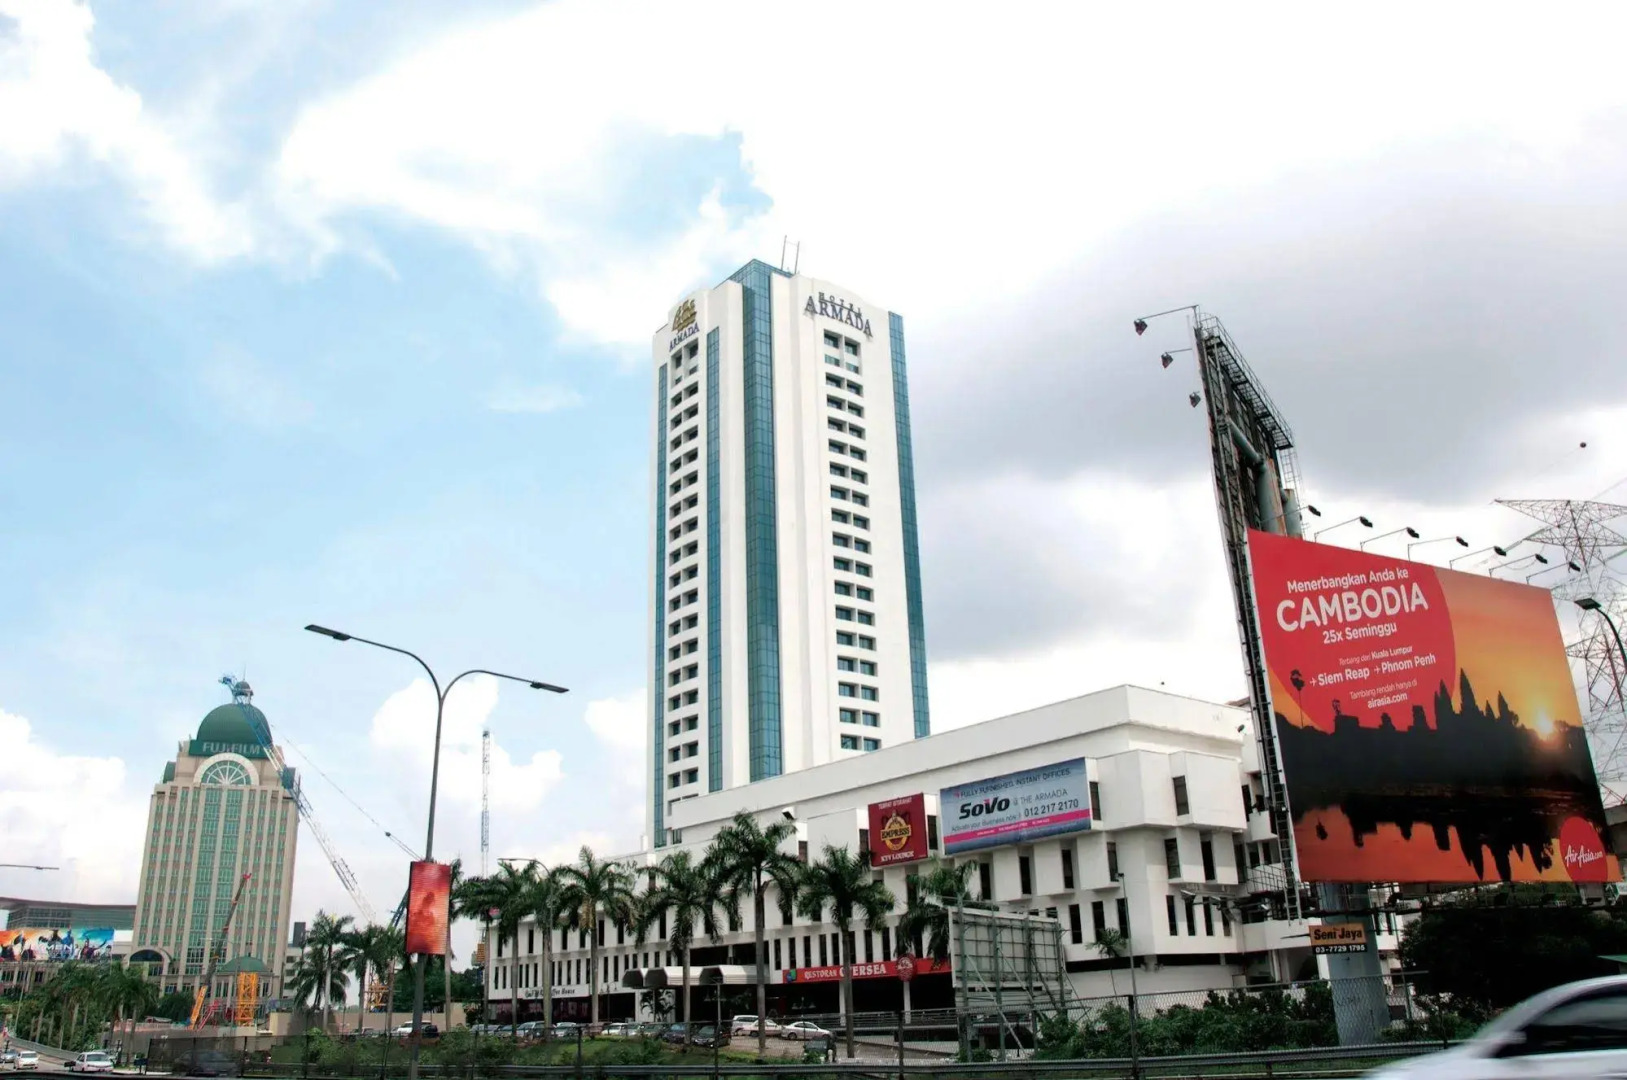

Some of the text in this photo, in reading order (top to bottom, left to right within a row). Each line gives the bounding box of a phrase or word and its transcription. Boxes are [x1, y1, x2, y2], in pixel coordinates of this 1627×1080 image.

[804, 296, 873, 337] ARMADA
[669, 322, 700, 352] ARMADA
[1287, 567, 1409, 594] Menerbangkan Anda ke
[1276, 582, 1429, 632] CAMBODIA
[1323, 622, 1397, 644] 25x Seminggu
[1371, 650, 1389, 660] Kuala
[1389, 645, 1413, 657] Lumpur
[1318, 652, 1436, 686] Siem Reap Phnom Penh
[1350, 687, 1376, 701] Tambang
[1367, 691, 1408, 710] airasia.com
[202, 741, 260, 755] FUJIFILM
[1035, 788, 1068, 801] ARMADA
[1024, 798, 1079, 817] 012 217 2170
[881, 827, 910, 839] EMPRESS
[1314, 927, 1362, 941] Seni Jaya
[1315, 945, 1347, 953] 03-7729
